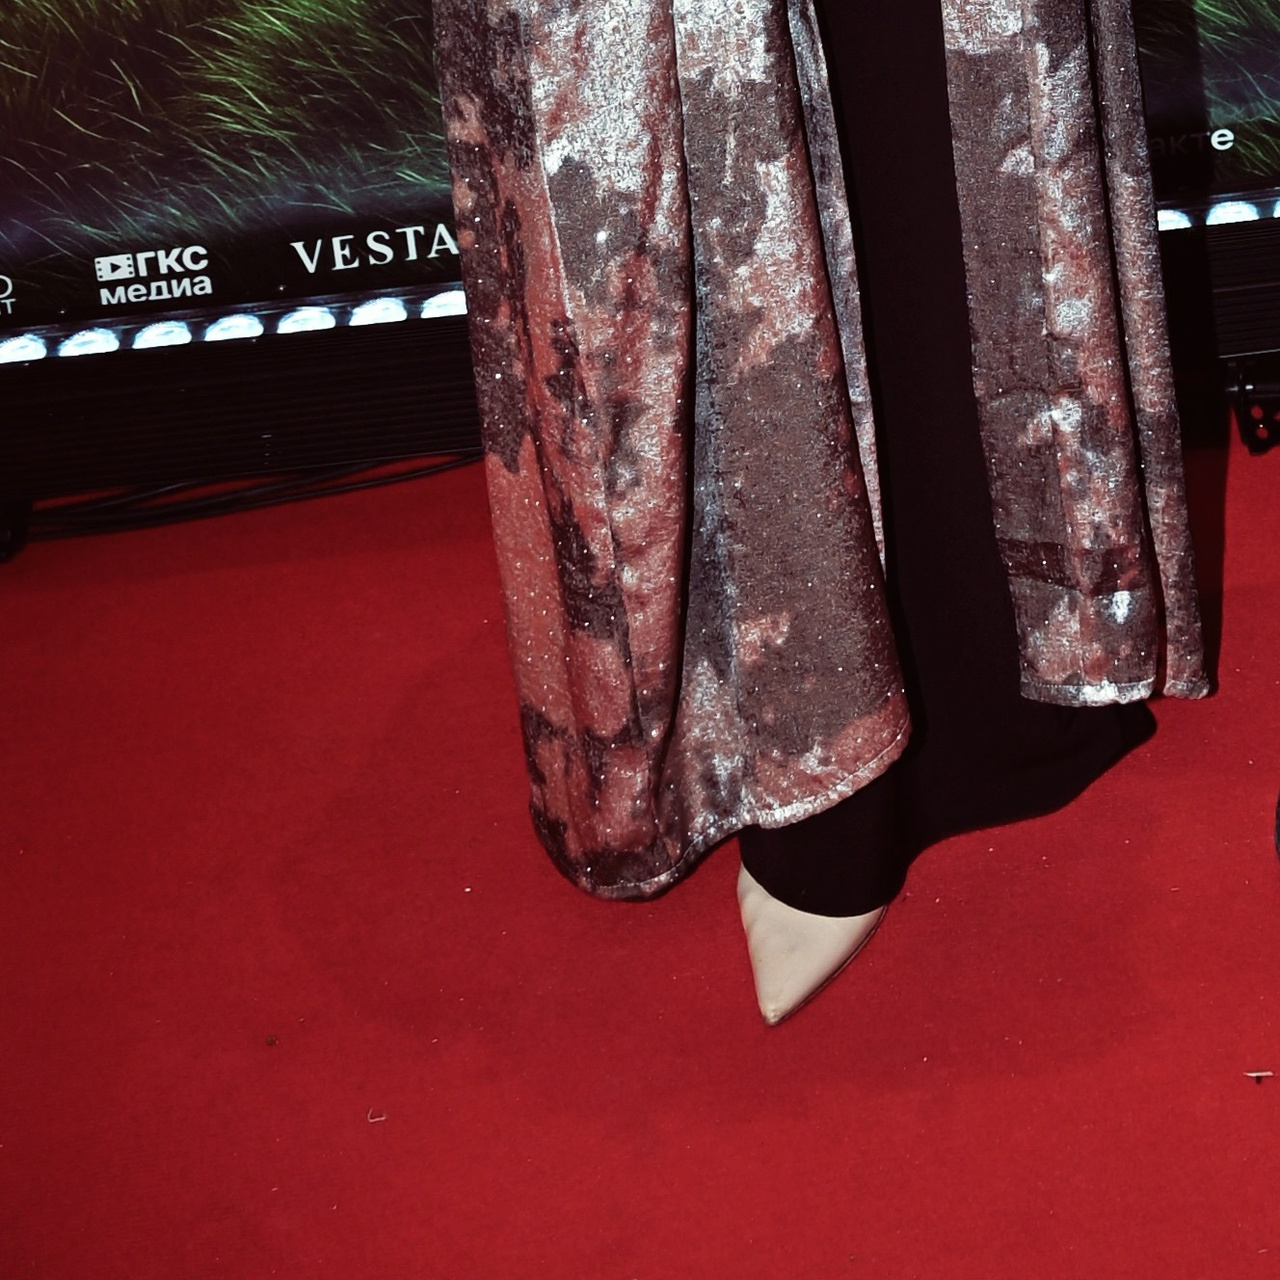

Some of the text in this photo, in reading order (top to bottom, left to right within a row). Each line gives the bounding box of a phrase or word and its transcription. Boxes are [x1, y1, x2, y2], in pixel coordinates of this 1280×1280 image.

[138, 245, 209, 278] ГКС
[290, 223, 461, 275] VESTA
[100, 273, 213, 306] медиа
